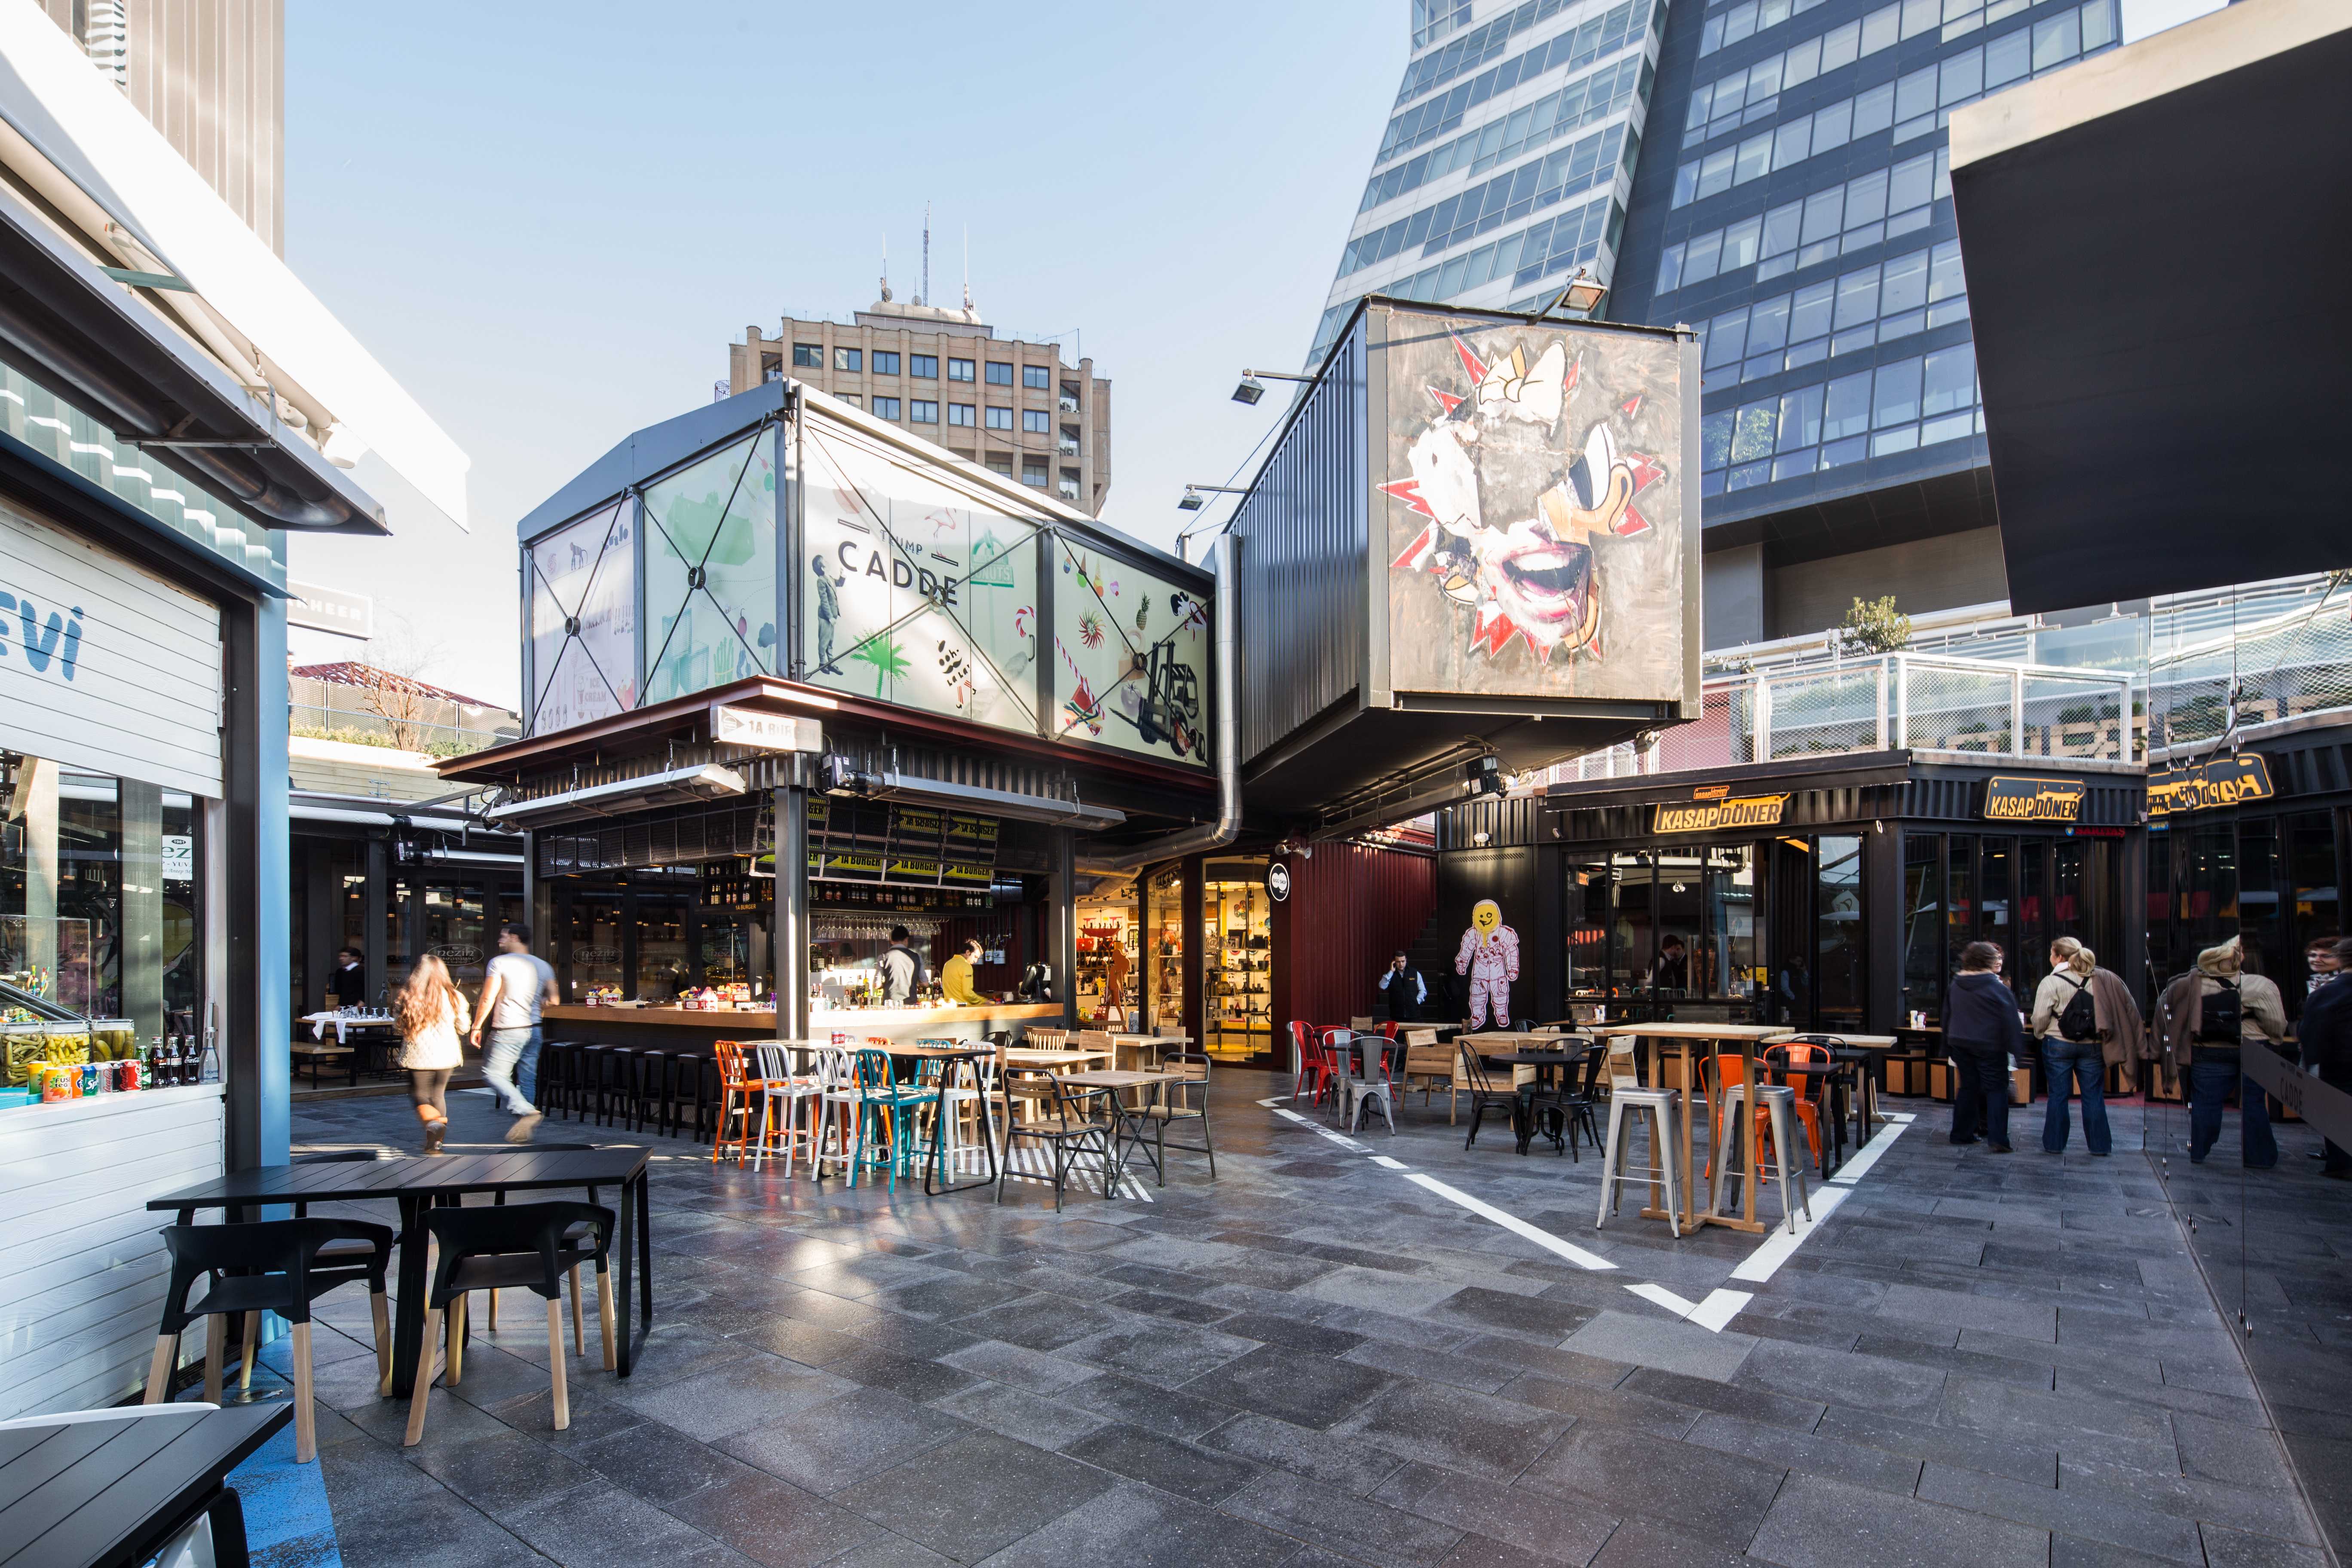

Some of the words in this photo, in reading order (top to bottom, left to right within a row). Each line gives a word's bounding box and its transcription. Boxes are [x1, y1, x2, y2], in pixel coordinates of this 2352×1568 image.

[880, 529, 922, 554] TRUMP
[837, 541, 959, 606] CADDE
[590, 677, 600, 688] ICE
[584, 691, 607, 702] CREAM
[749, 720, 763, 734] 1A
[841, 855, 849, 864] 1A
[851, 856, 881, 867] BURGER
[901, 861, 909, 869] 1A
[910, 861, 937, 871] BURGER
[965, 867, 989, 876] BURGER
